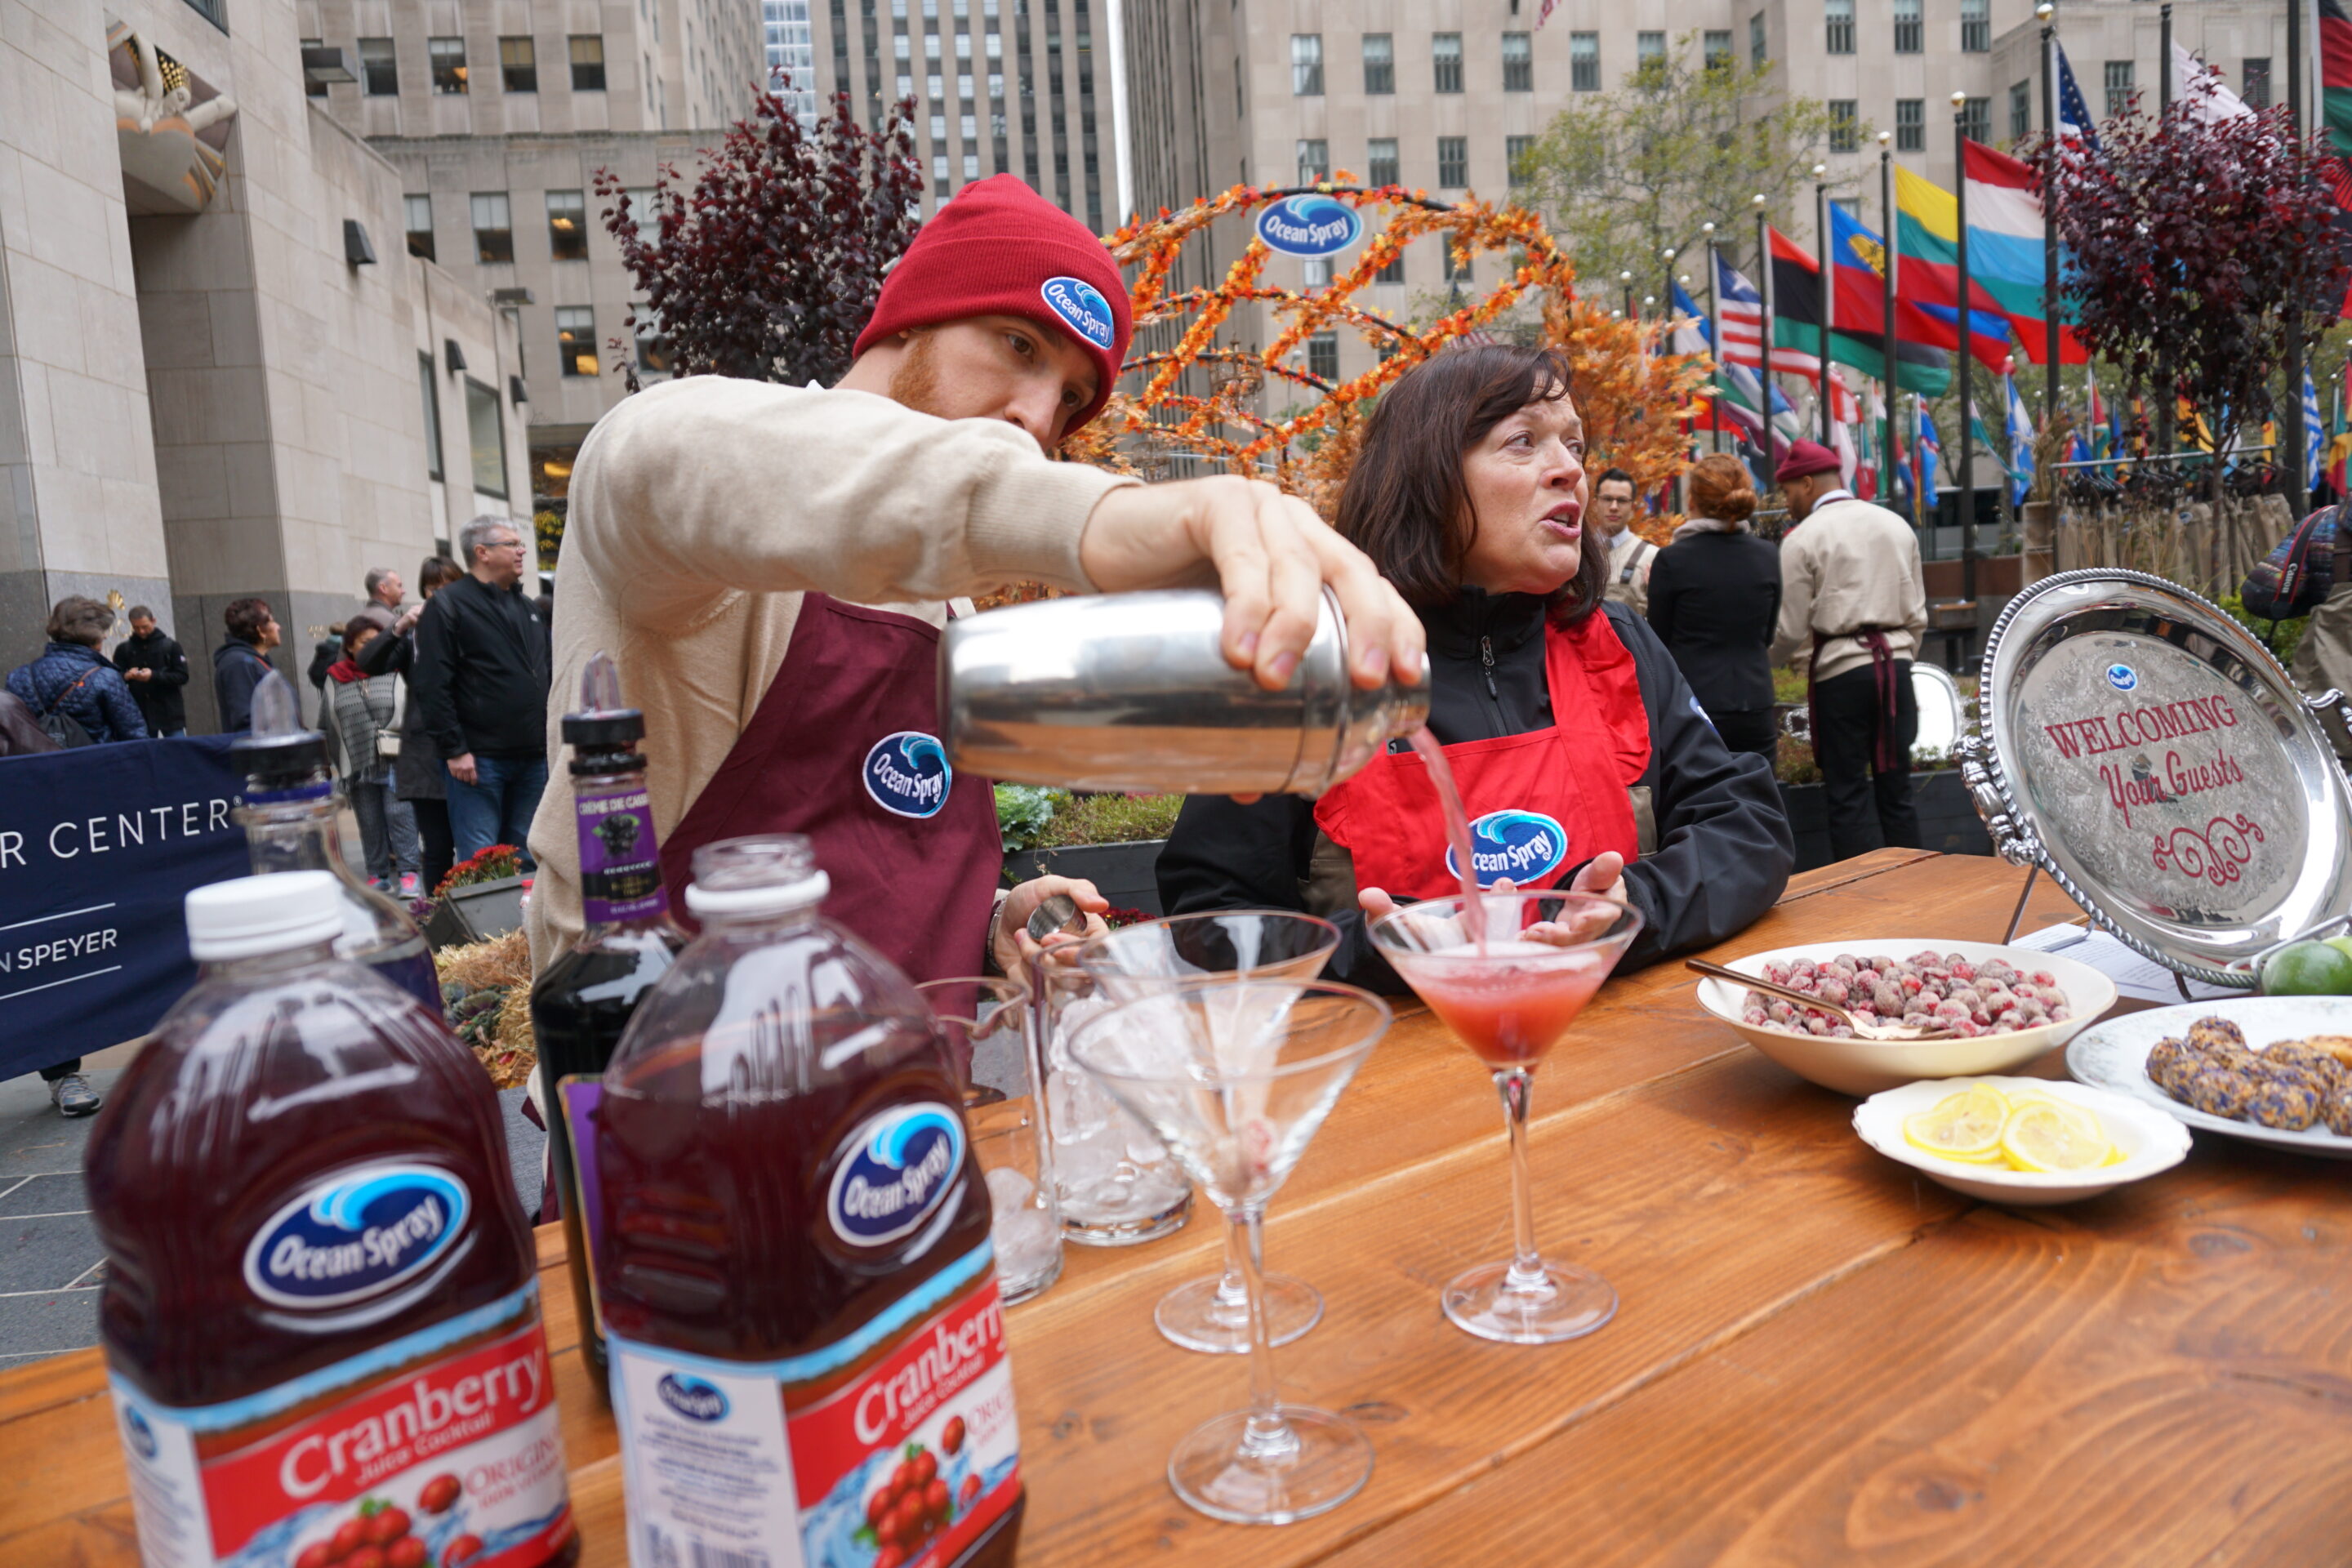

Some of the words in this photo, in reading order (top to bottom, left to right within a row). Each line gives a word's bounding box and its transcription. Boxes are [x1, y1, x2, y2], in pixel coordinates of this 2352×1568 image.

[1265, 215, 1307, 243] Ocean
[1308, 216, 1349, 248] Spray
[1048, 283, 1084, 321] Ocean
[1082, 310, 1111, 343] Spray
[2281, 562, 2298, 594] Canon
[2043, 694, 2238, 760] WELCOMING
[609, 797, 626, 810] DE
[873, 753, 913, 797] Ocean
[911, 770, 943, 804] Spray
[2100, 764, 2167, 830] Your
[2166, 748, 2244, 796] Guests
[49, 798, 229, 858] CENTER
[1468, 844, 1509, 872] cean
[1507, 830, 1552, 871] Spray
[17, 928, 118, 970] SPEYER
[844, 1174, 905, 1219] Ocean
[902, 1132, 951, 1205] Spray
[270, 1233, 365, 1281] Ocean
[363, 1194, 443, 1267] Spray
[279, 1346, 544, 1499] Cranberry
[354, 1443, 412, 1486] Juice
